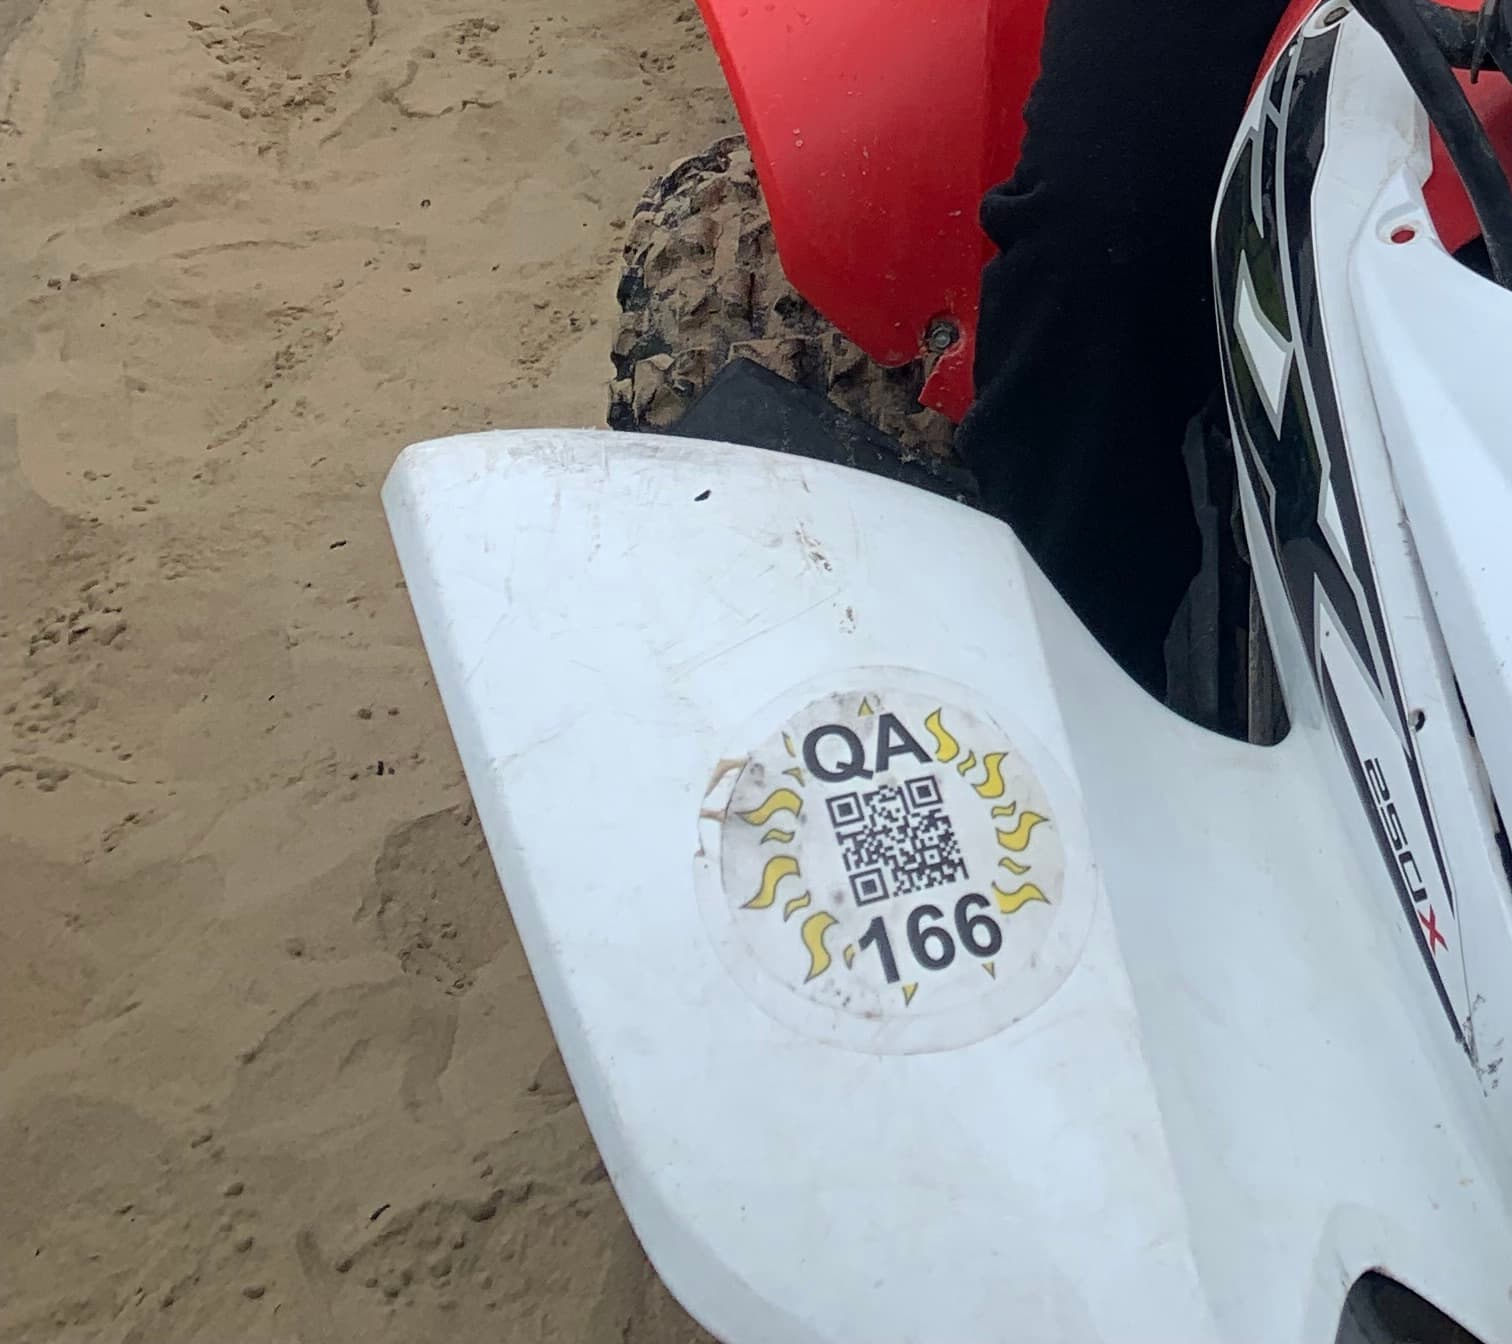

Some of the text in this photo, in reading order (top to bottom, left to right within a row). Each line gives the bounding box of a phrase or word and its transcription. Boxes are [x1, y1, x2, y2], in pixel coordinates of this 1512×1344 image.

[801, 712, 934, 784] QA
[1363, 757, 1449, 958] 250X
[858, 892, 1002, 985] 166
